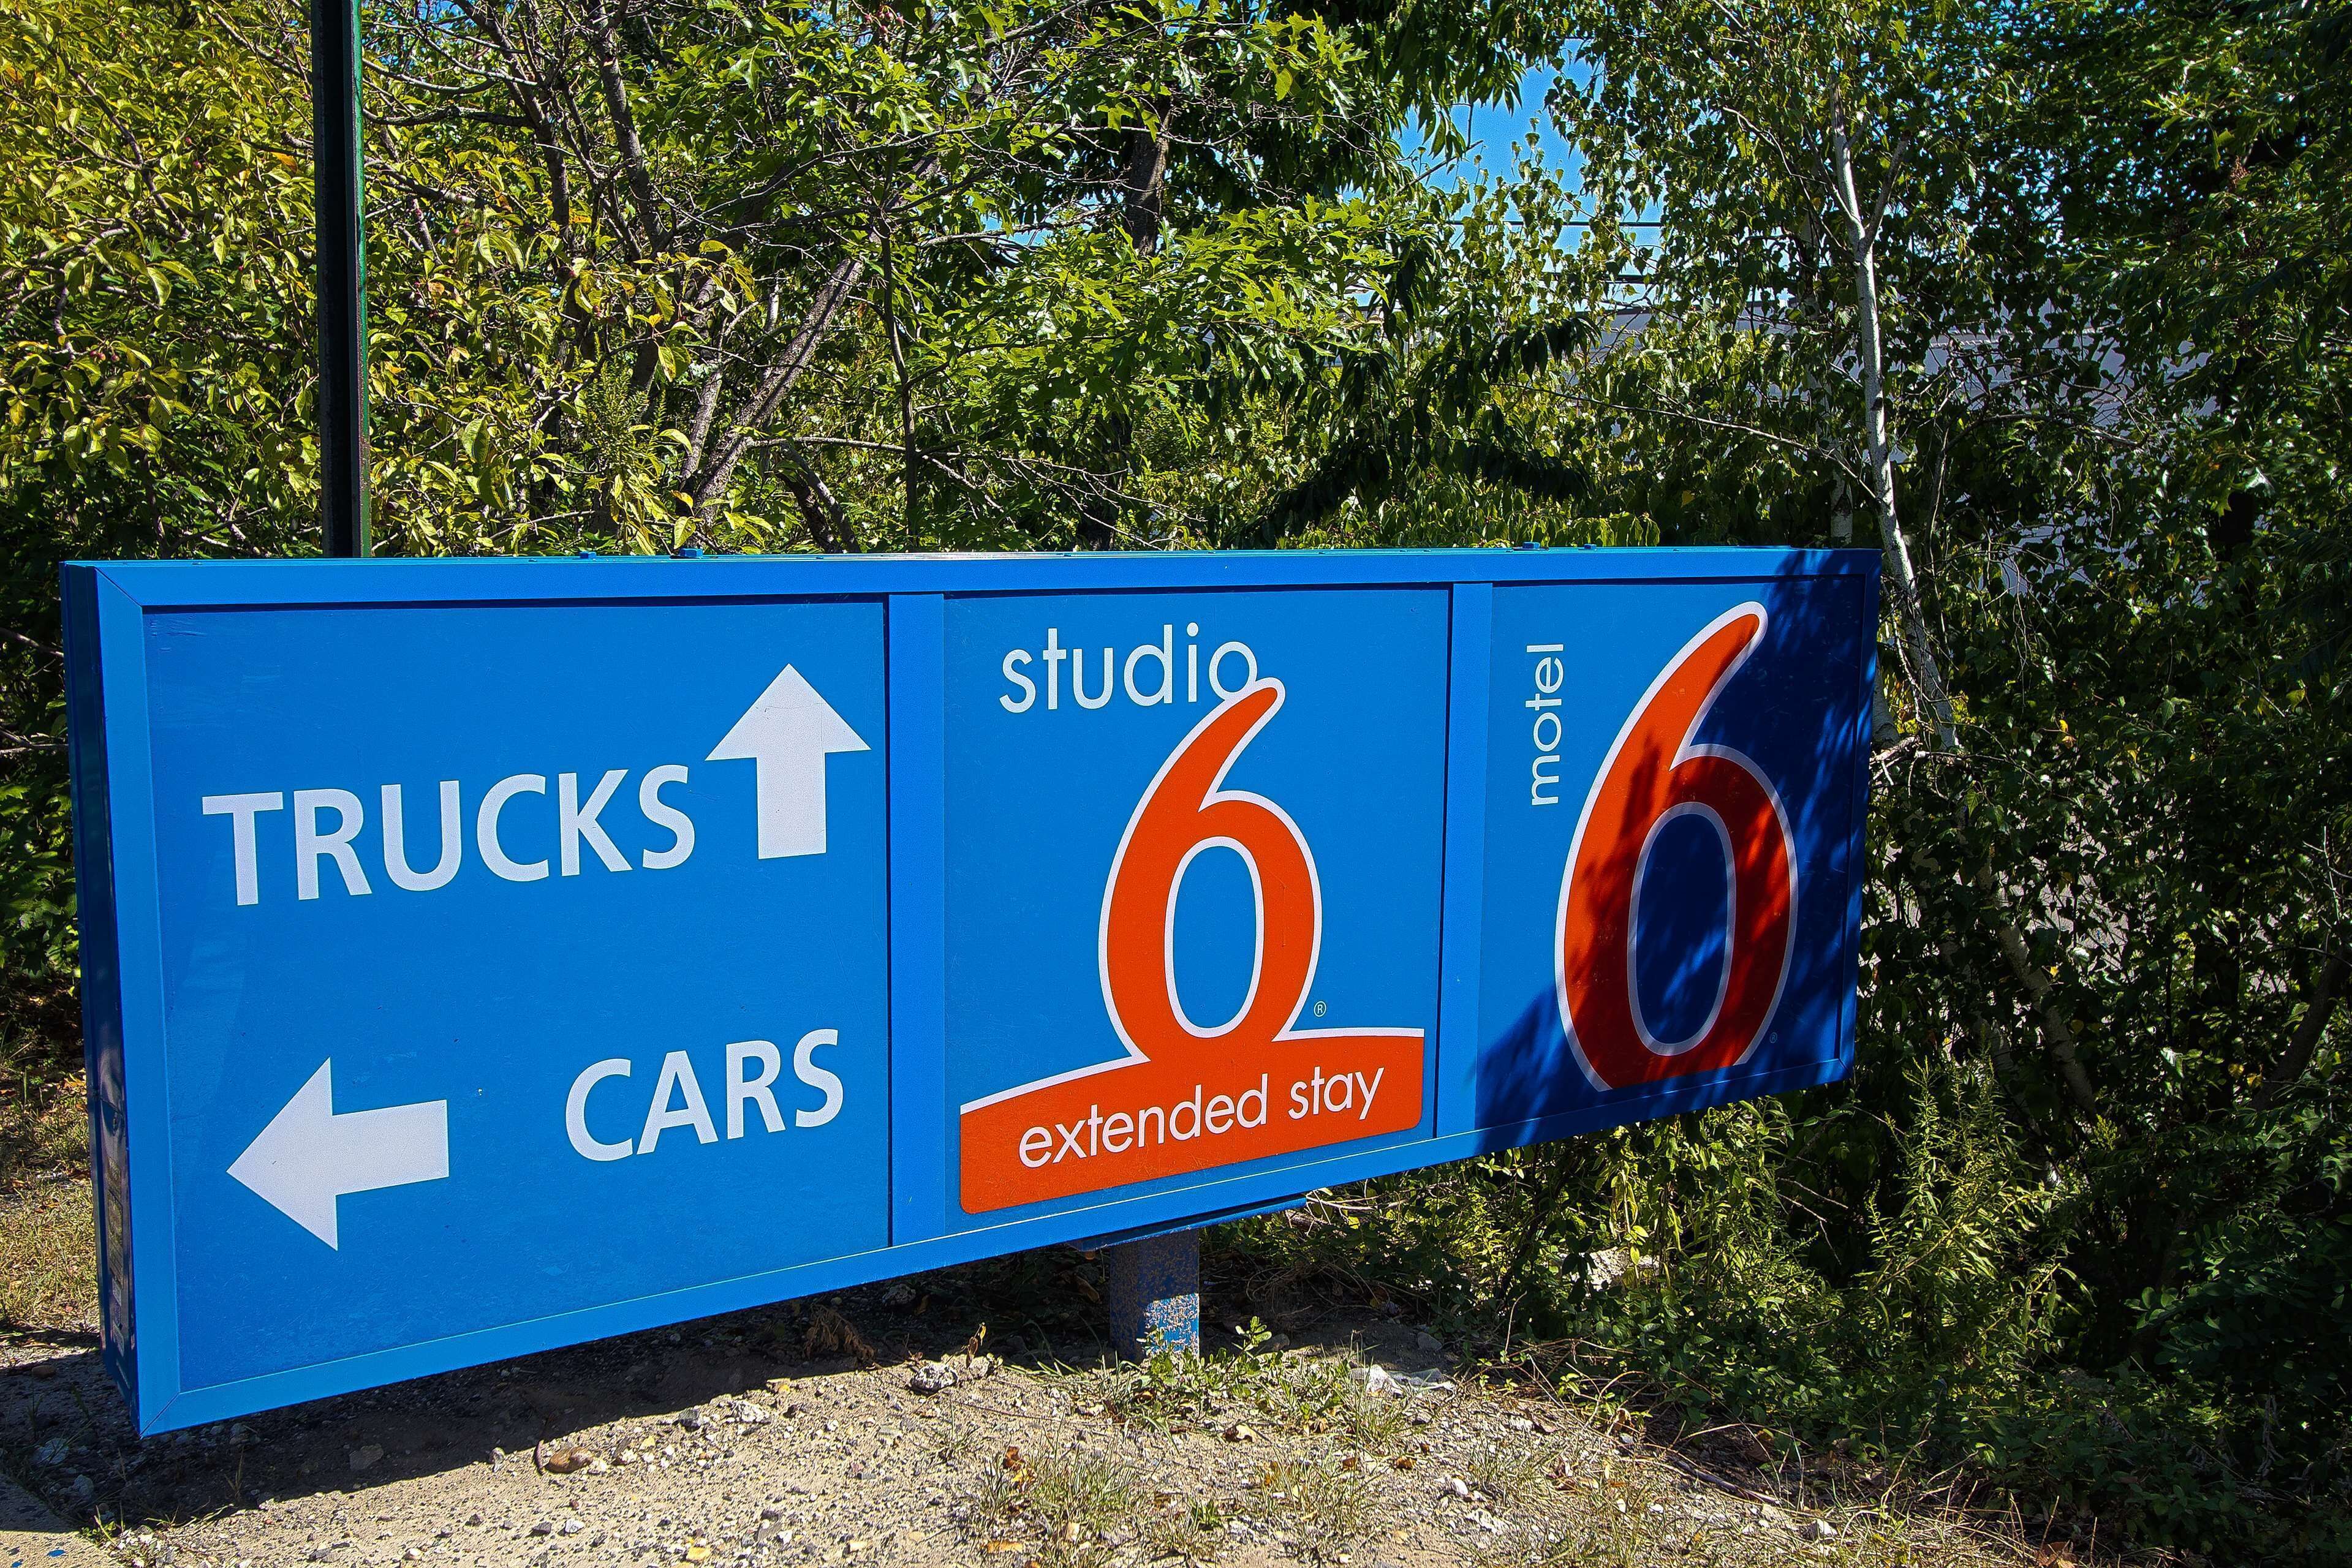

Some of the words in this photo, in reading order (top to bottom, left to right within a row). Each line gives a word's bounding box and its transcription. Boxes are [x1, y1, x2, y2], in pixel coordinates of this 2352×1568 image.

[1000, 622, 1257, 713] studio
[1526, 644, 1564, 805] motel
[203, 765, 695, 907] TRUCKS
[1098, 677, 1323, 1061] 6
[1556, 601, 1798, 1091] 6
[565, 1028, 844, 1162] CARS
[1018, 1073, 1268, 1169] extended
[1288, 1066, 1385, 1120] stay
